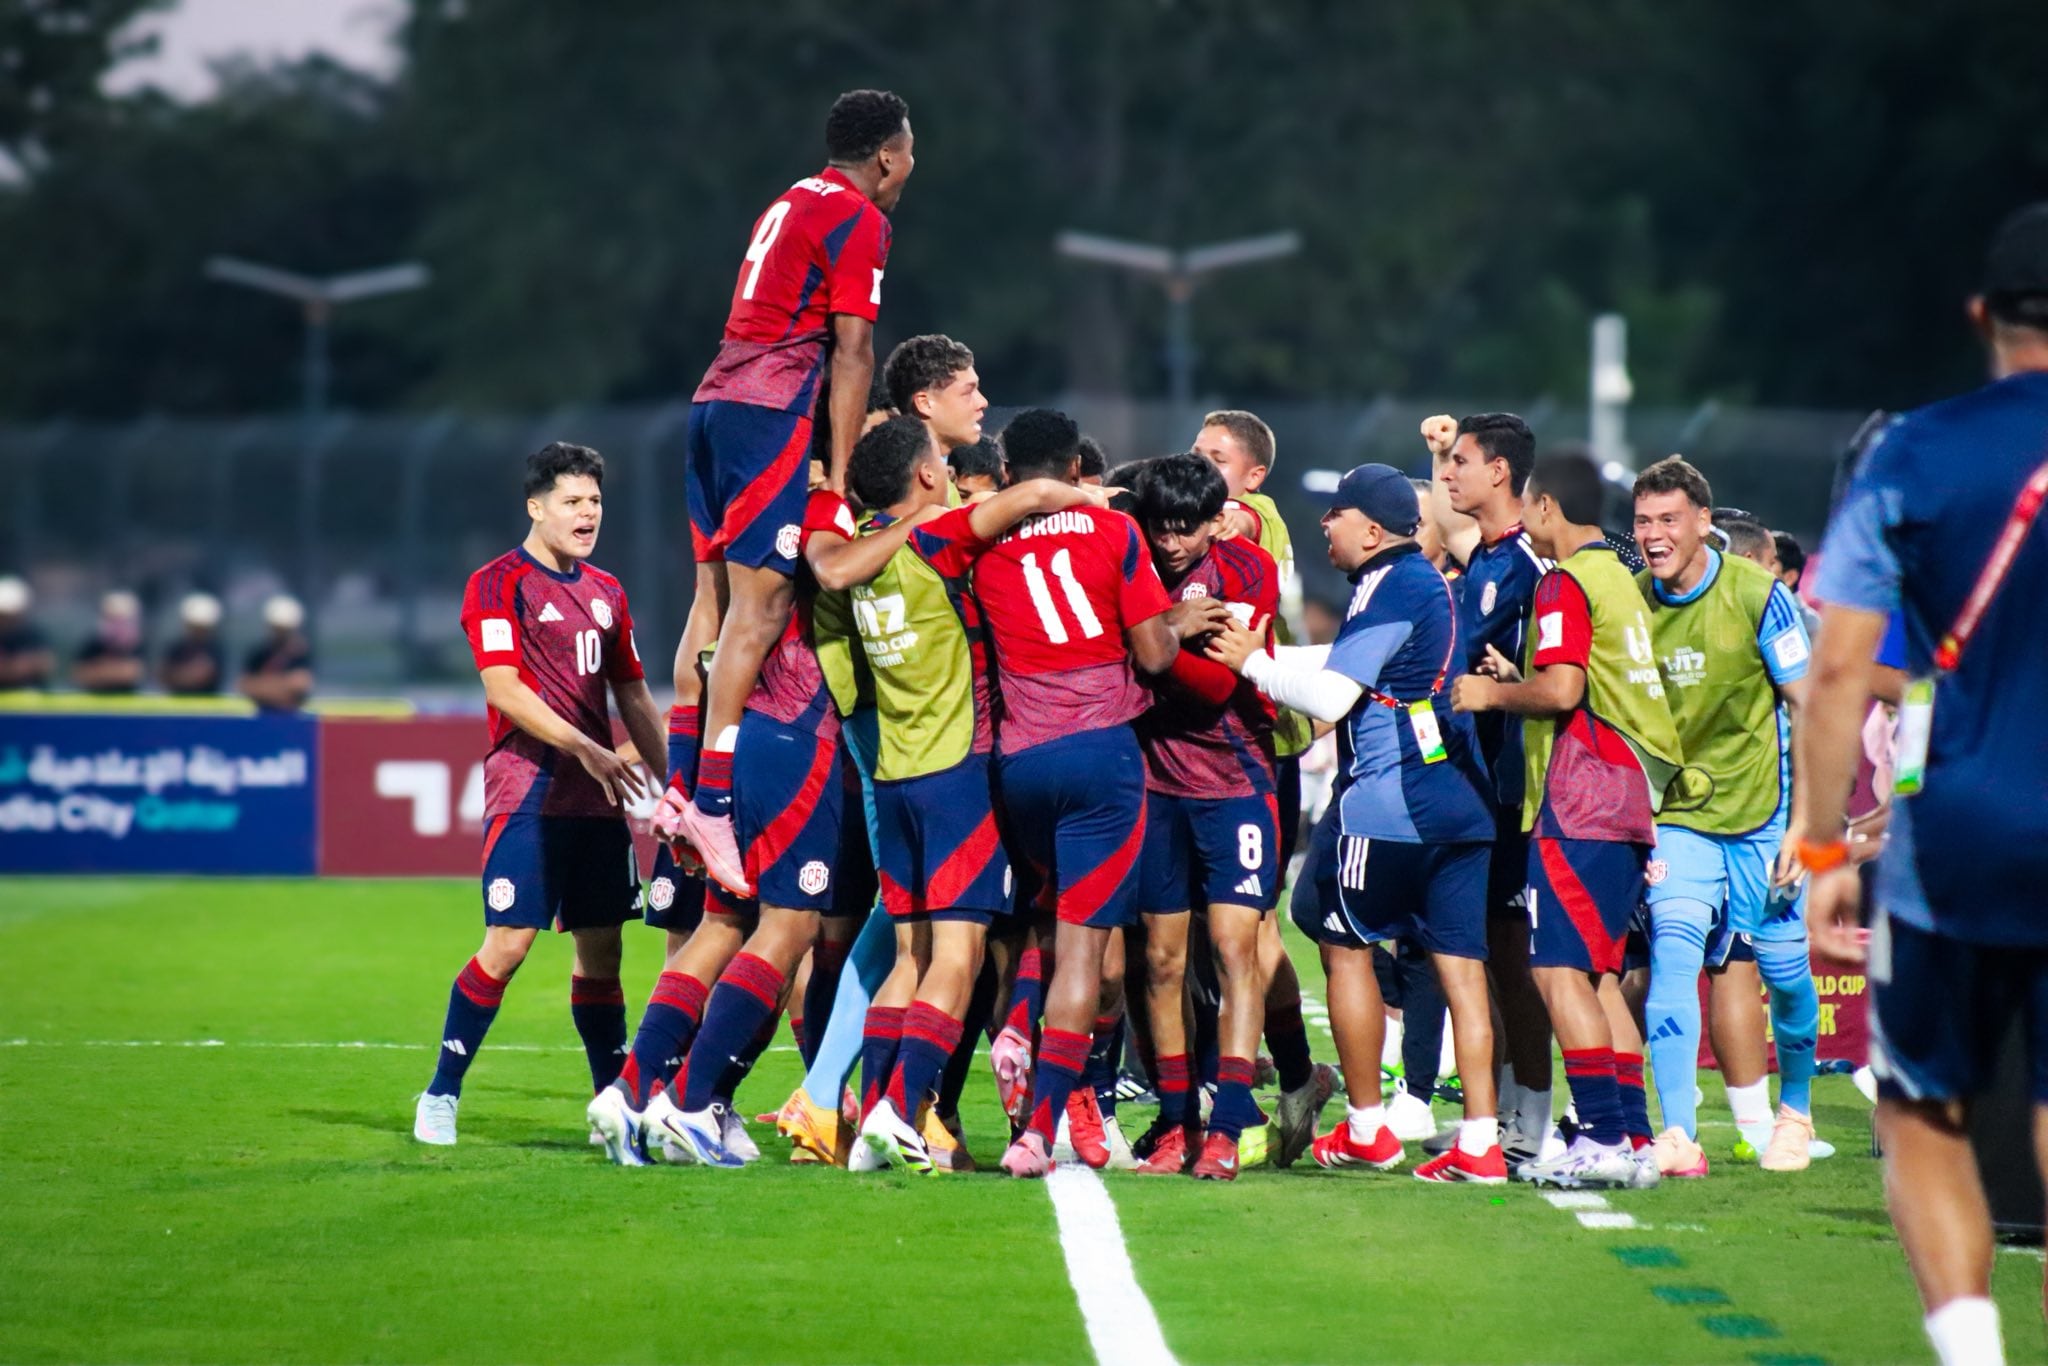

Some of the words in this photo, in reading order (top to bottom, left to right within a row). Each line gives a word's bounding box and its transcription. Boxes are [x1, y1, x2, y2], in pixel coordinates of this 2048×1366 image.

[742, 201, 791, 300] 9
[1020, 548, 1105, 645] 11
[576, 629, 602, 676] 10
[1238, 823, 1263, 870] 8
[1838, 975, 1866, 996] CUP
